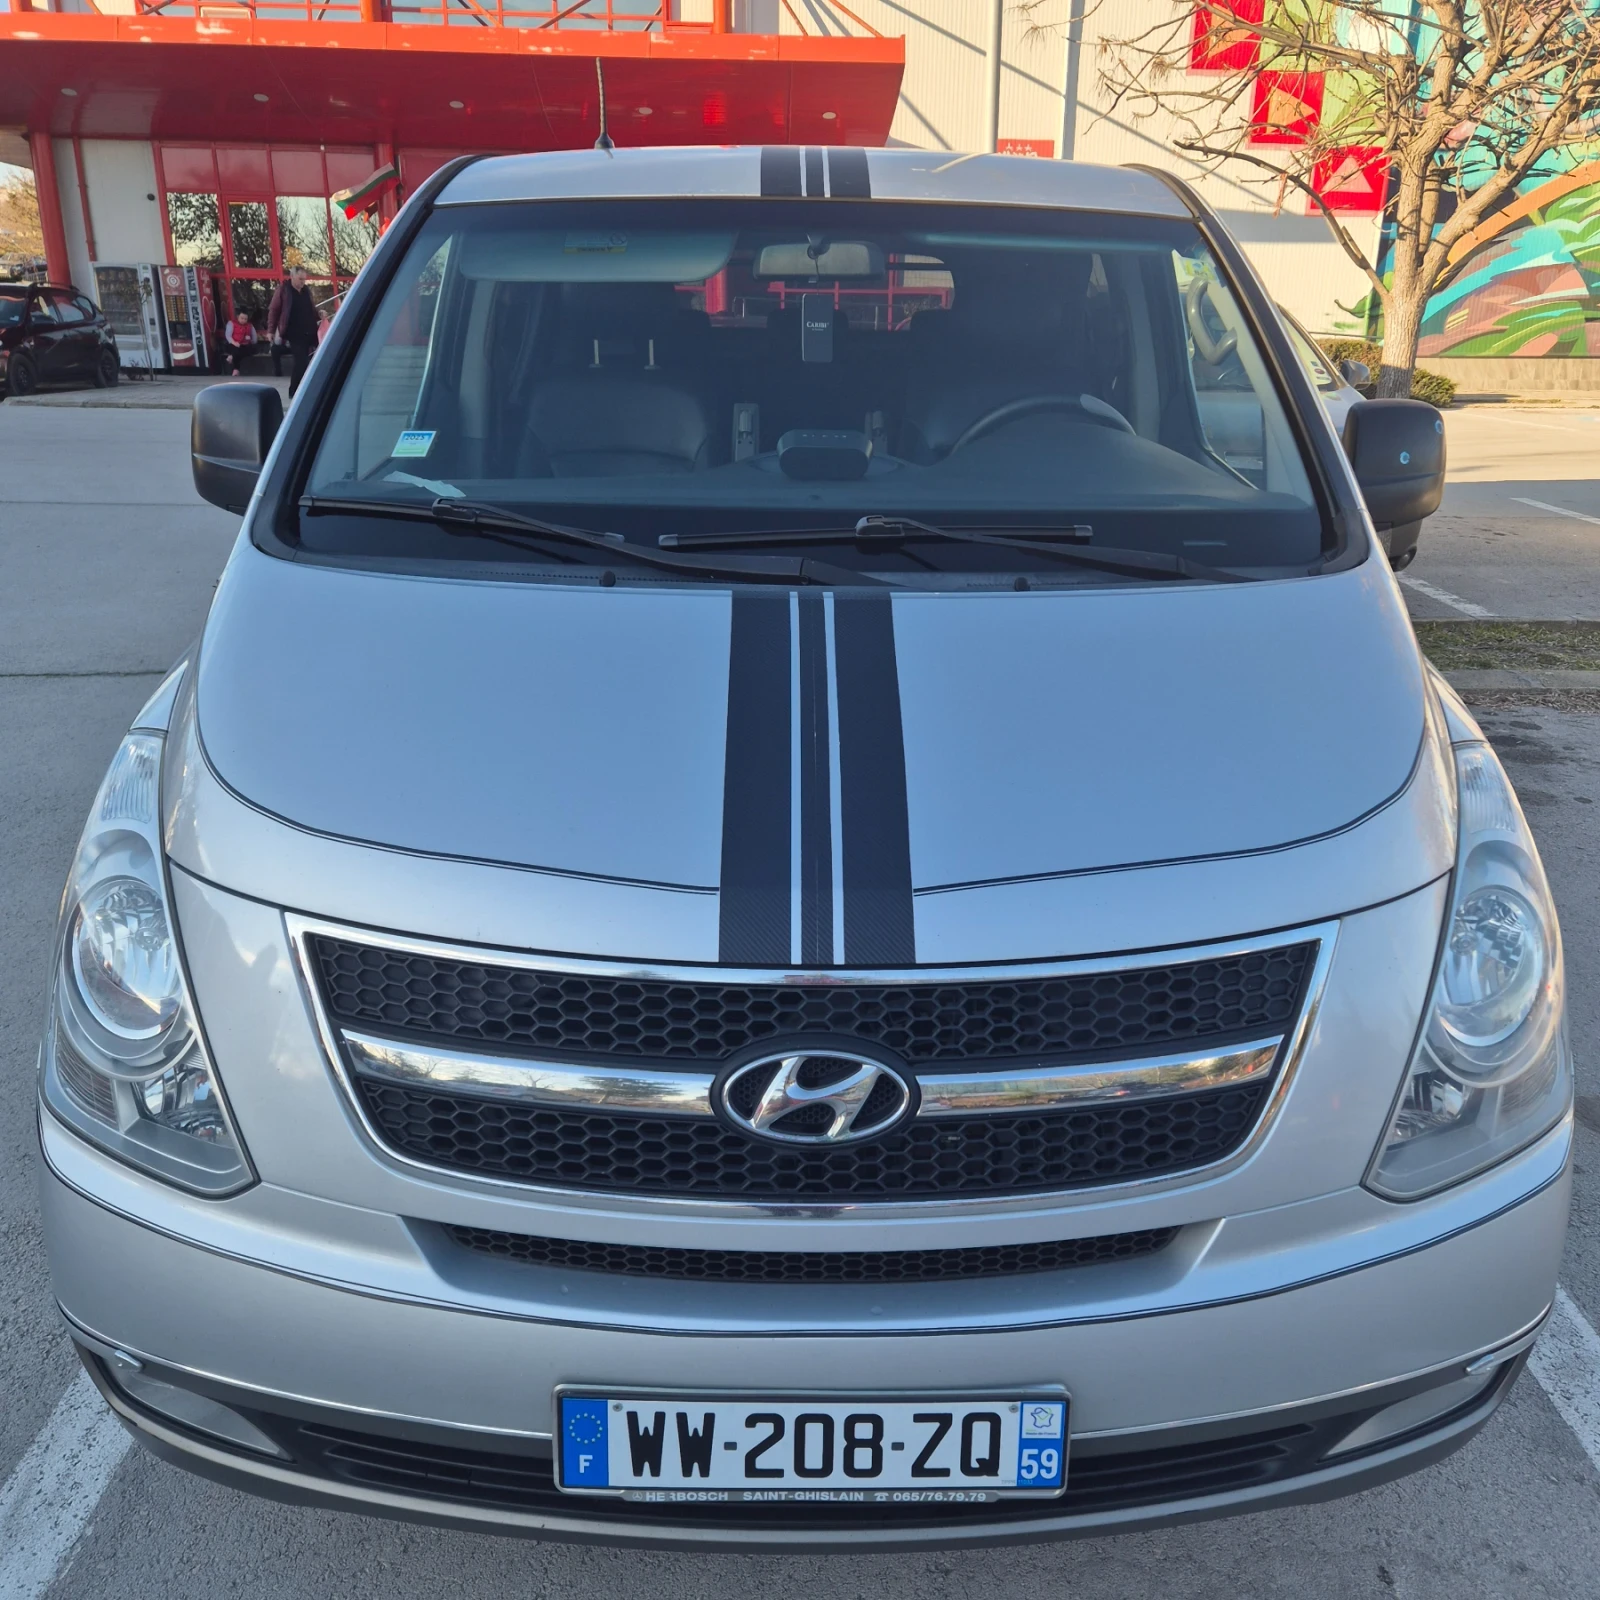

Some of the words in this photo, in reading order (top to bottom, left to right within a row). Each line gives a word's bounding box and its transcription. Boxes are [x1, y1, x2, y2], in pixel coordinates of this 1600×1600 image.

[626, 1411, 1003, 1478] WW-208-ZQ
[579, 1454, 593, 1474] F
[1020, 1448, 1059, 1480] 59
[743, 1491, 864, 1502] SAINT-GHISLAIN
[893, 1491, 986, 1502] 065/76.79.79
